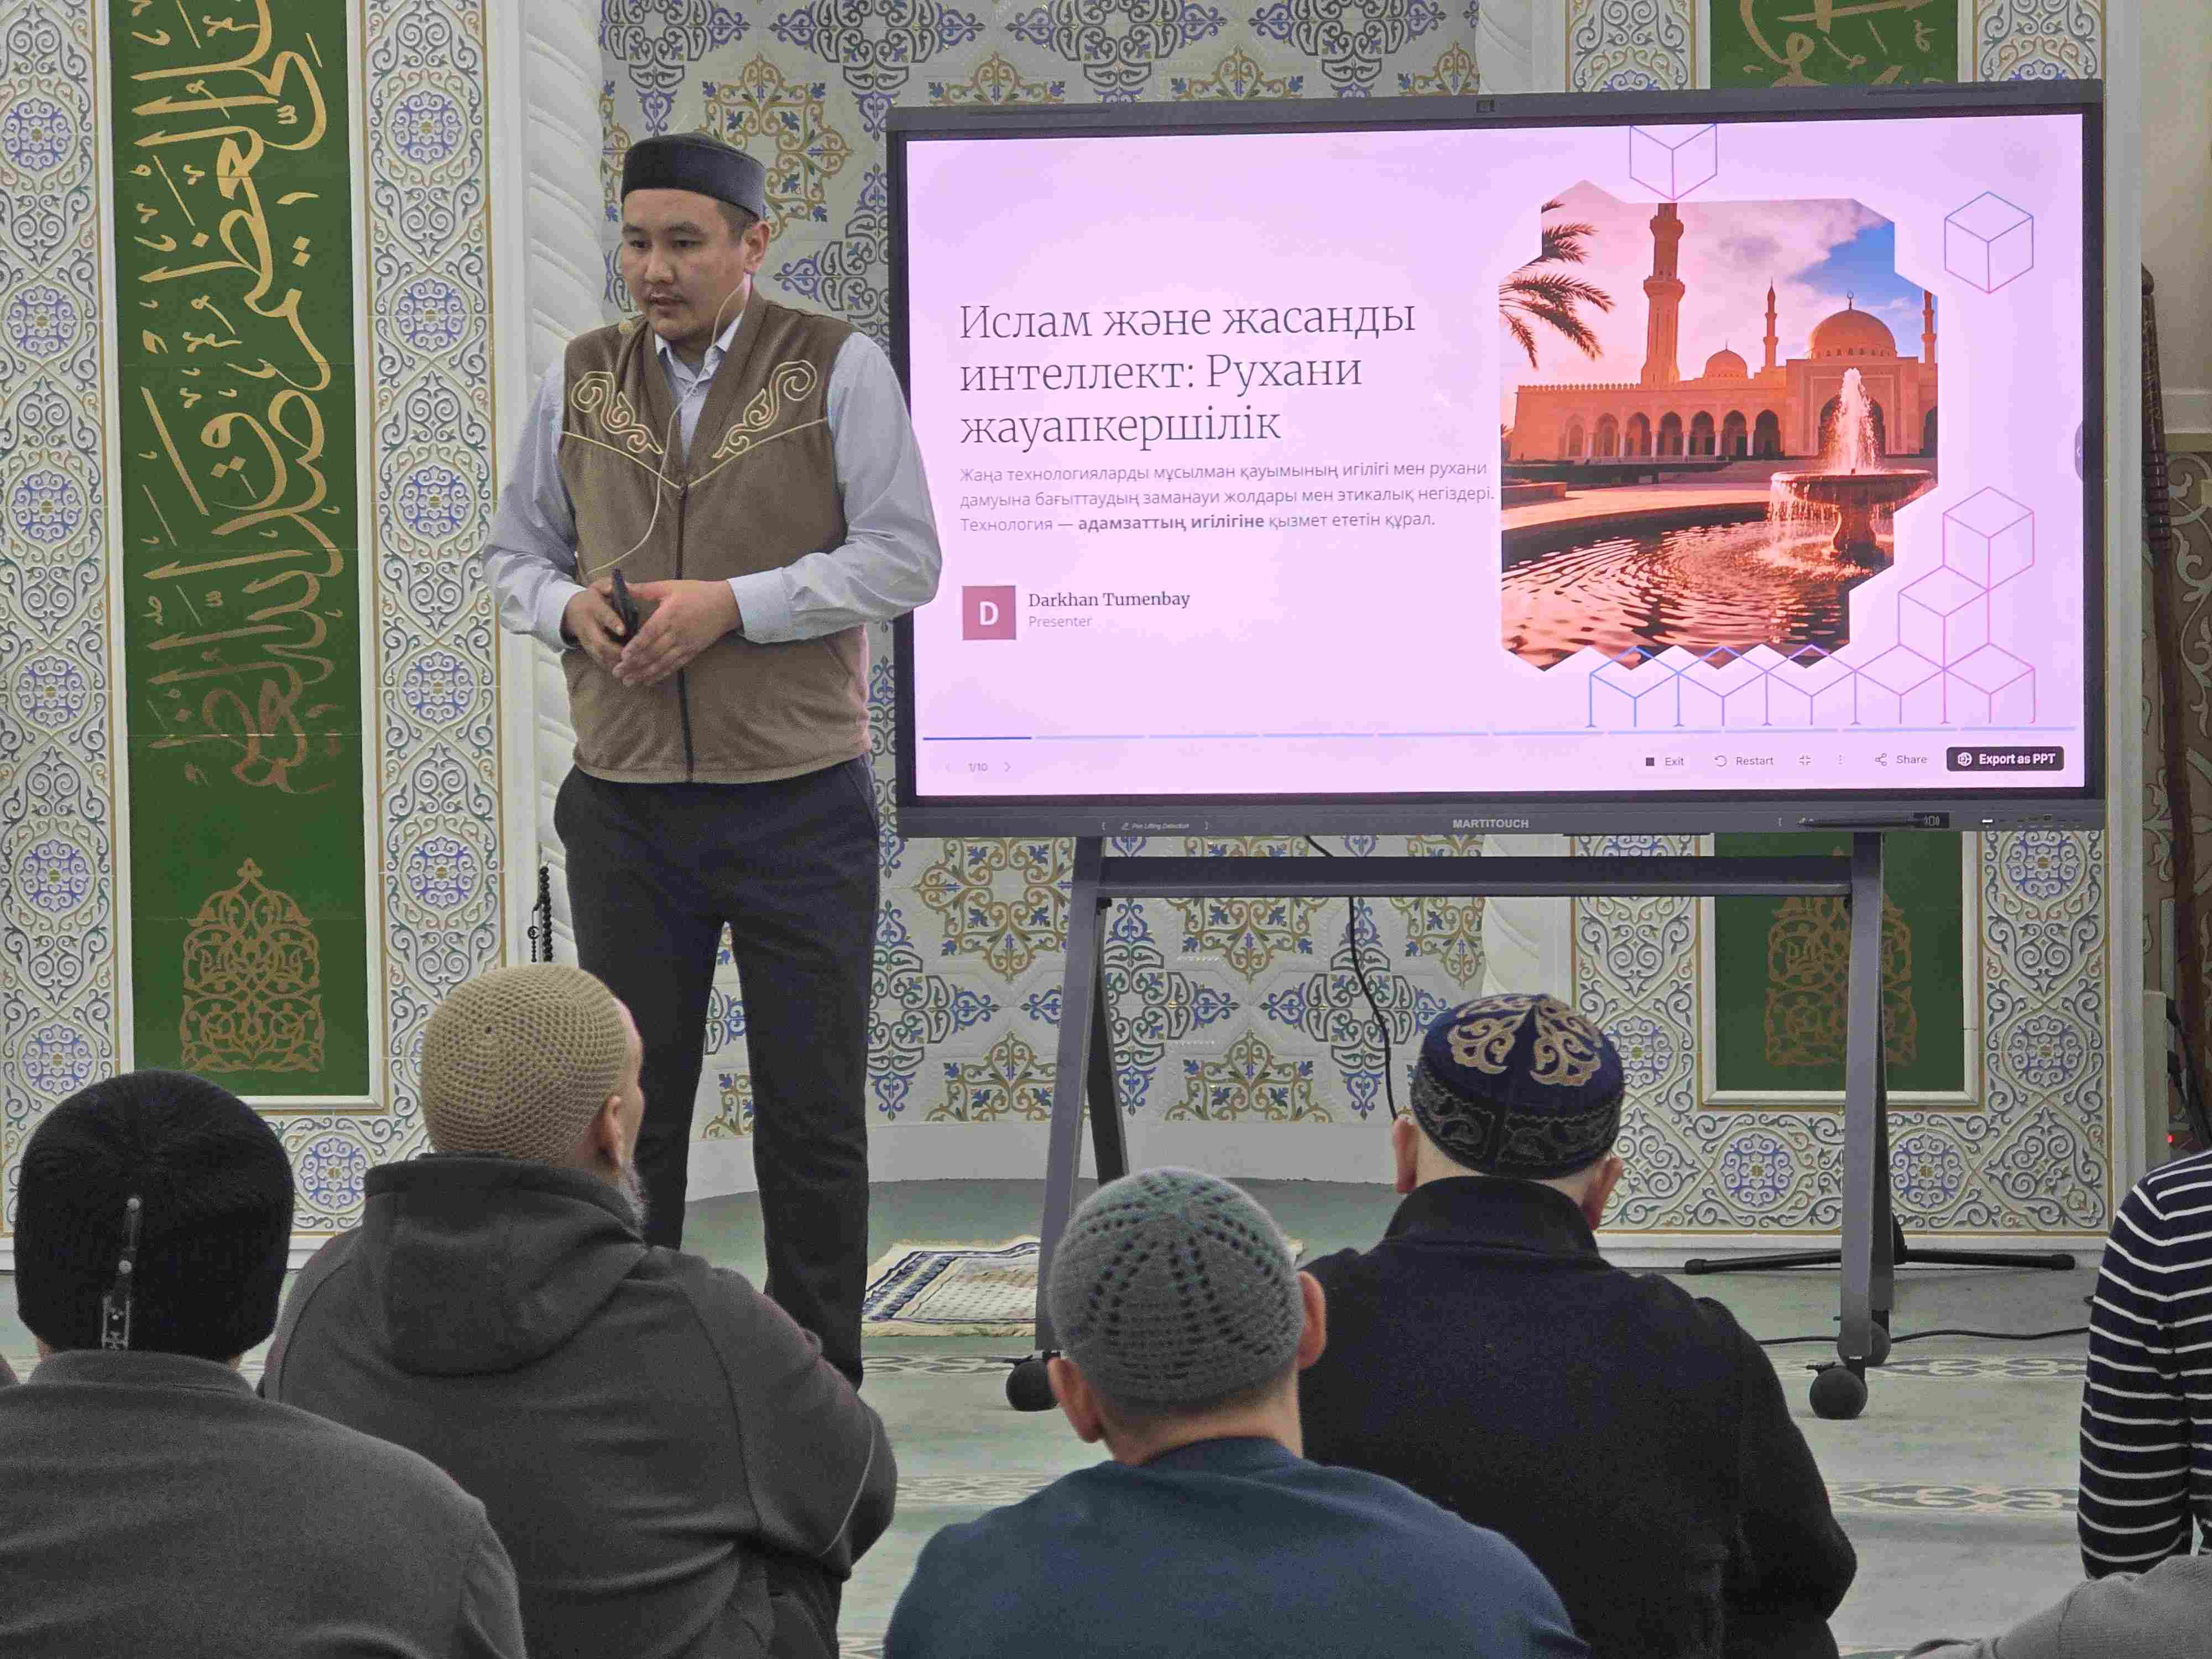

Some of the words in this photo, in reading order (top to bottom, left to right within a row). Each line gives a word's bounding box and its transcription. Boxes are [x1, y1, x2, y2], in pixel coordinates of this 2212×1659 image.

[960, 305, 1092, 338] Ислам
[1103, 307, 1211, 336] және
[1222, 303, 1416, 340] жасанды
[960, 361, 1193, 392] интеллект:
[1206, 353, 1363, 398] Рухани
[960, 405, 1282, 453] жауапкершілік
[960, 468, 1003, 484] Жаңа
[1007, 467, 1149, 483] технологияларды
[1154, 467, 1235, 483] мұсылман
[1240, 465, 1338, 481] қауымының
[1343, 462, 1389, 476] игілігі
[1394, 465, 1425, 476] мен
[1430, 463, 1487, 479] рухани
[960, 496, 1031, 509] дамуына
[1035, 492, 1139, 508] бағыттаудың
[1143, 493, 1219, 507] заманауи
[1224, 491, 1297, 506] жолдары
[1301, 491, 1334, 502] мен
[1337, 489, 1415, 504] этикалық
[1418, 487, 1495, 503] негіздері.
[960, 518, 1053, 531] Технология
[1078, 517, 1186, 533] адамзаттың
[1191, 514, 1265, 529] игілігіне
[1269, 515, 1327, 529] қызмет
[1332, 514, 1381, 527] ететін
[1385, 514, 1437, 529] құрал.
[1029, 592, 1099, 607] Darkhan
[1103, 591, 1190, 609] Tumenbay
[979, 601, 999, 625] D
[1029, 615, 1092, 628] Presenter
[968, 761, 988, 773] 1/10
[1665, 757, 1686, 766] Exit
[1736, 756, 1774, 766] Restart
[1896, 754, 1928, 765] Share
[1979, 753, 2016, 767] Export
[2017, 755, 2031, 764] as
[2033, 753, 2056, 764] PPT
[1452, 818, 1530, 828] MARTITOUCH
